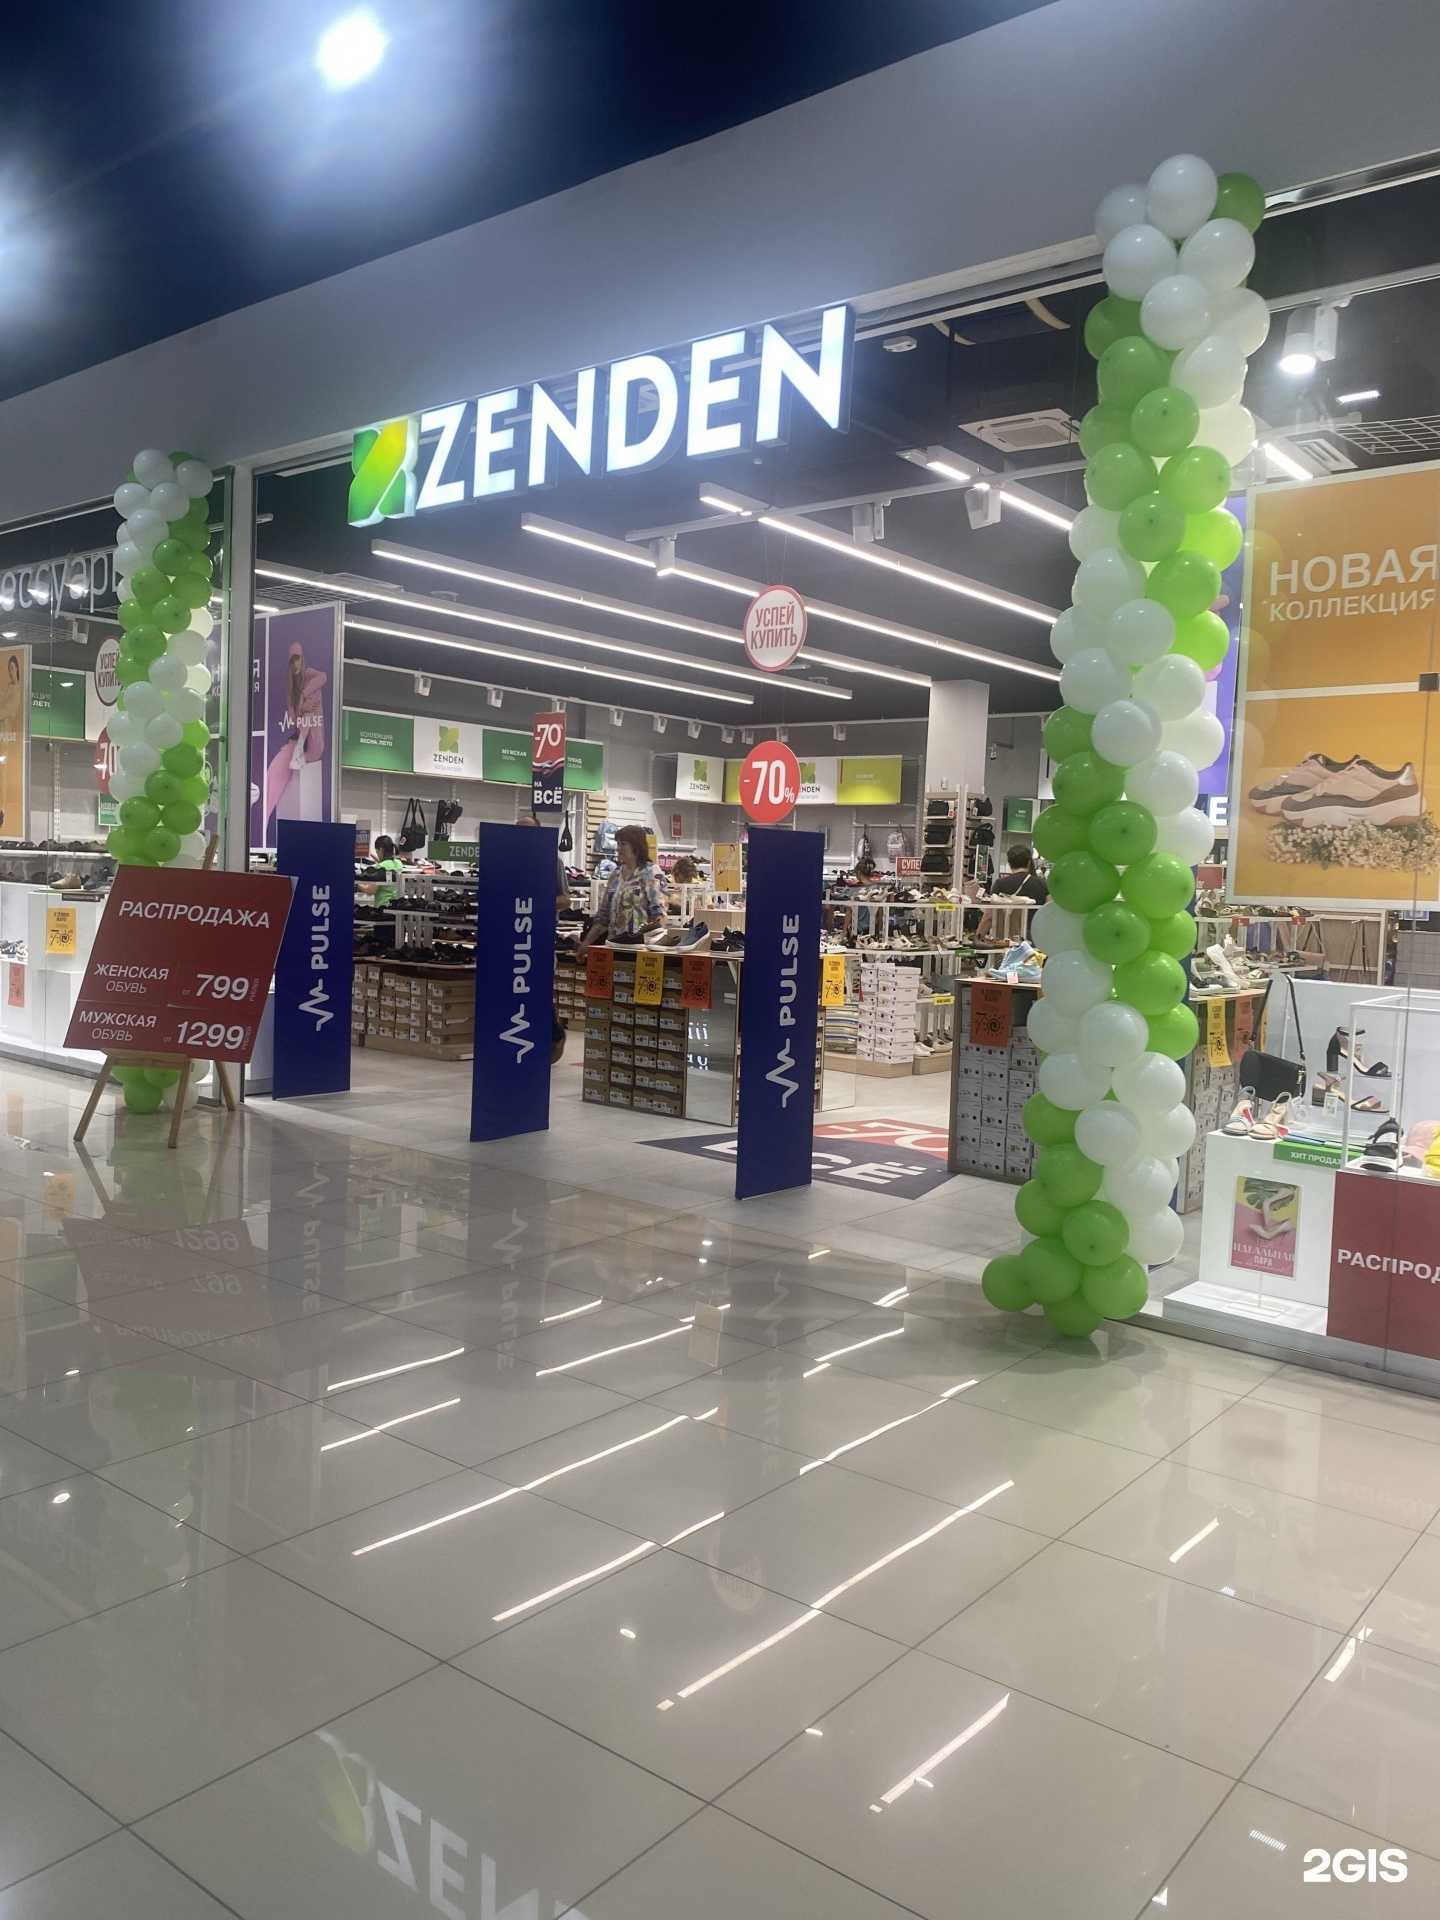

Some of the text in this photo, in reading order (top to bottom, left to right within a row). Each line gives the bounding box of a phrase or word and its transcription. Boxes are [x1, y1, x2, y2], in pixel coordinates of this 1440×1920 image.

[416, 304, 847, 509] ZENDEN
[1269, 543, 1440, 596] НОВАЯ
[756, 601, 795, 627] УСПЕЙ
[1269, 588, 1437, 622] КОЛЛЕКЦИЯ
[750, 627, 798, 650] КУПИТЬ
[296, 716, 324, 727] PULSE
[432, 753, 464, 764] ZENDEN
[743, 759, 795, 805] -70%
[800, 785, 821, 793] NDEN
[533, 786, 563, 804] ВСЁ
[449, 845, 480, 858] ZENDE
[901, 858, 920, 870] СУПЕ
[118, 900, 271, 929] РАСПРОДАЖА
[310, 884, 331, 970] PULSE
[512, 897, 533, 994] PULSE
[94, 963, 169, 980] ЖЕНСКАЯ
[779, 914, 800, 1027] PULSE
[105, 980, 147, 994] ОБУВЬ
[196, 973, 249, 1001] 799
[79, 1010, 157, 1028] МУЖСКАЯ
[91, 1027, 133, 1042] ОБУВЬ
[178, 1021, 245, 1050] 1299
[1290, 1151, 1341, 1166] ХИТ ПРОДА
